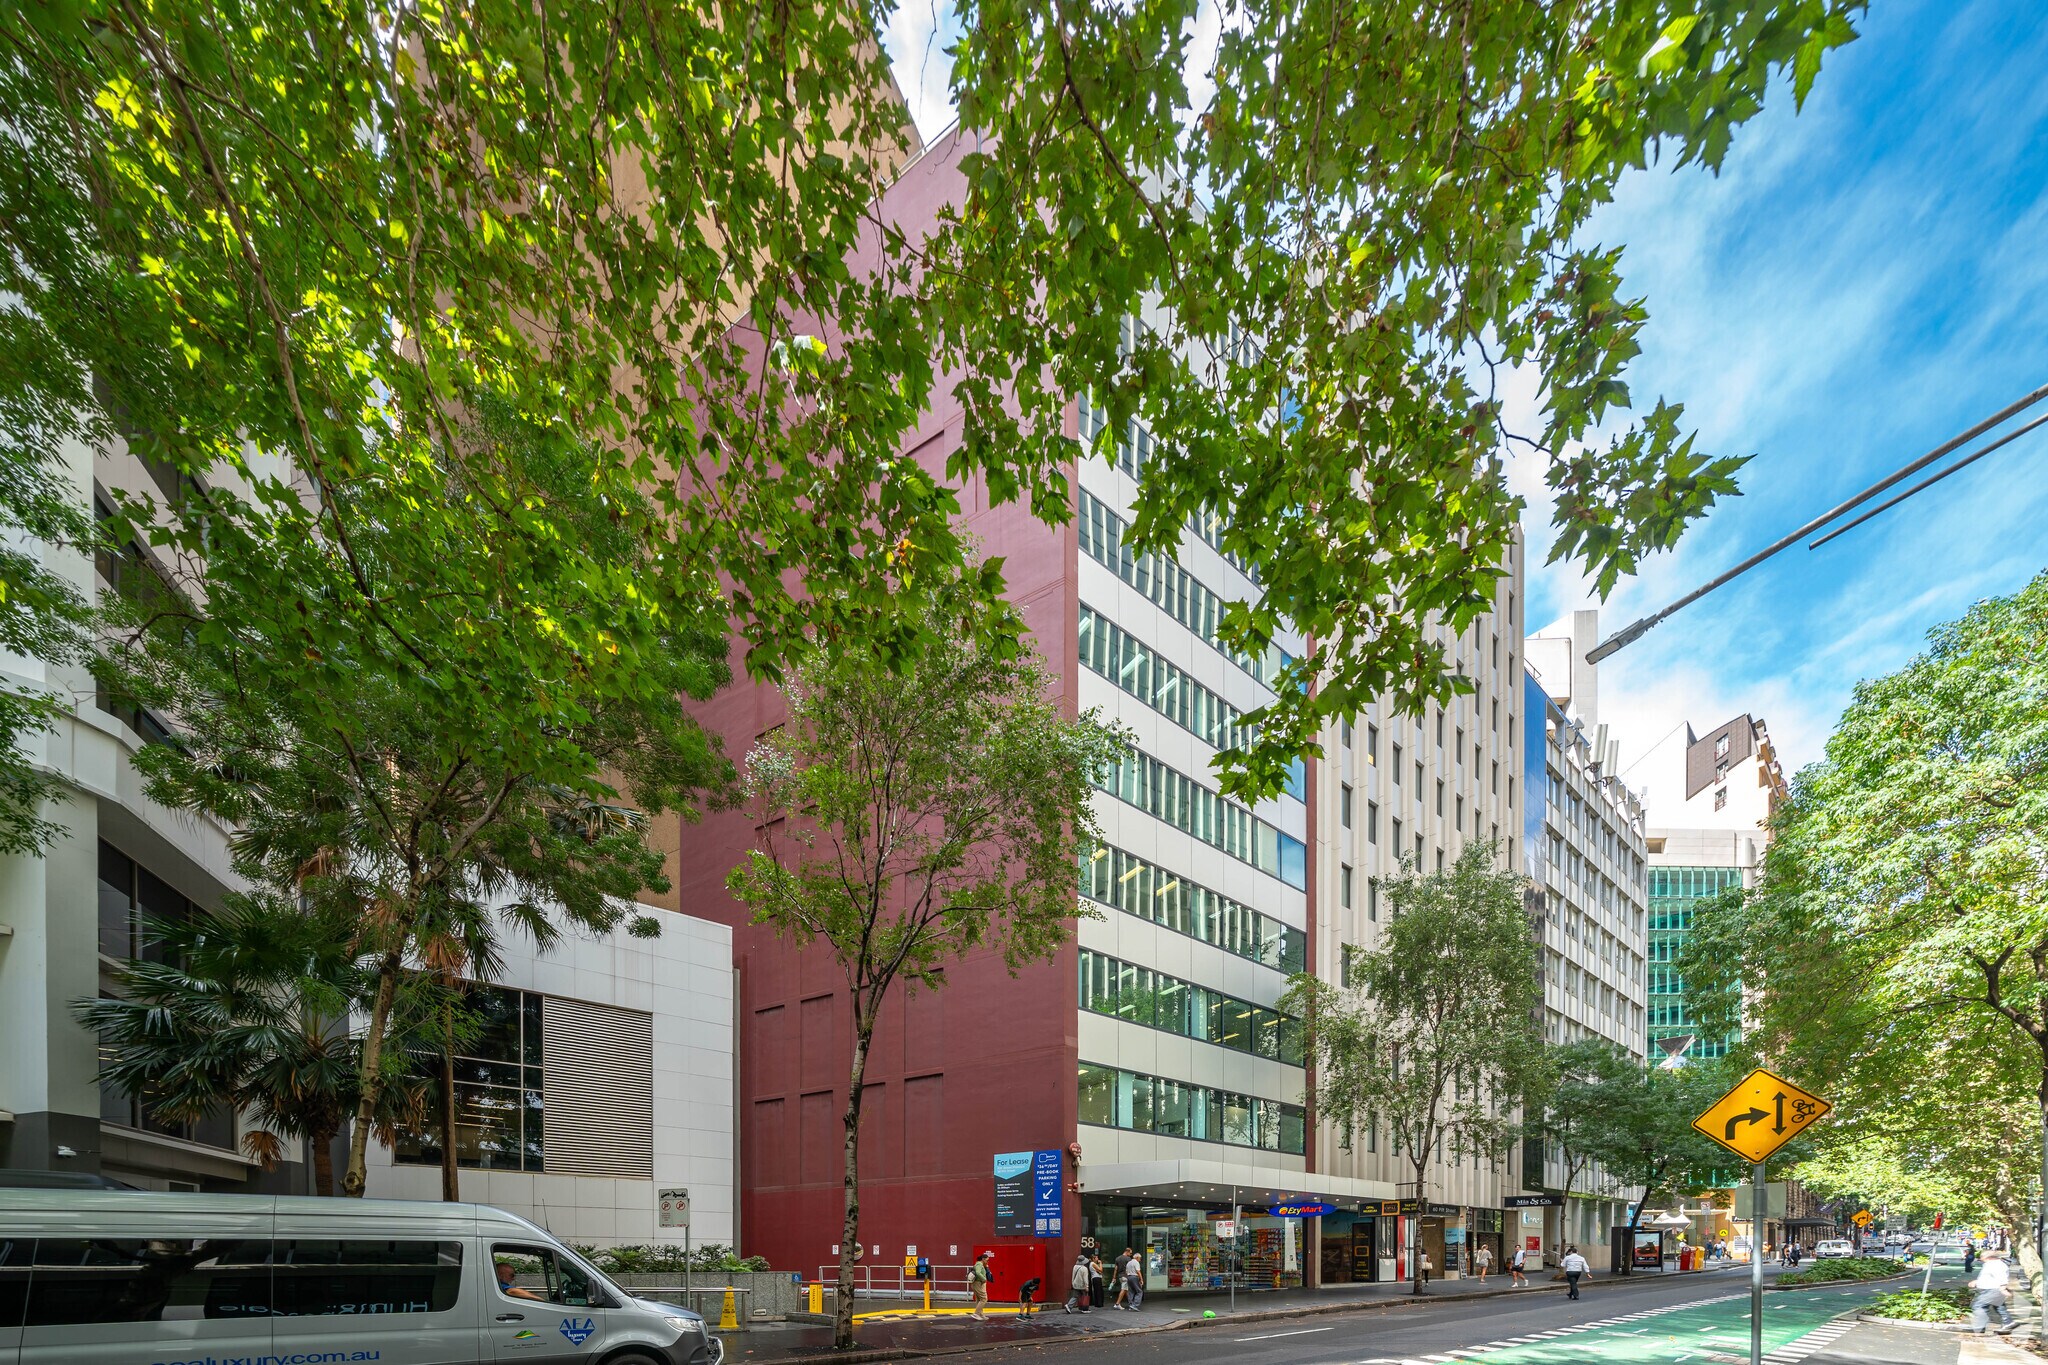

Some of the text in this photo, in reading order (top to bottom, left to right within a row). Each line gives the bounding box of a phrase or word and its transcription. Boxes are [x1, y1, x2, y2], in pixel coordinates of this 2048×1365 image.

[1009, 1158, 1029, 1166] Lease
[1288, 1206, 1322, 1215] EzyMart
[1081, 1236, 1095, 1248] 58
[559, 1318, 596, 1330] AEA
